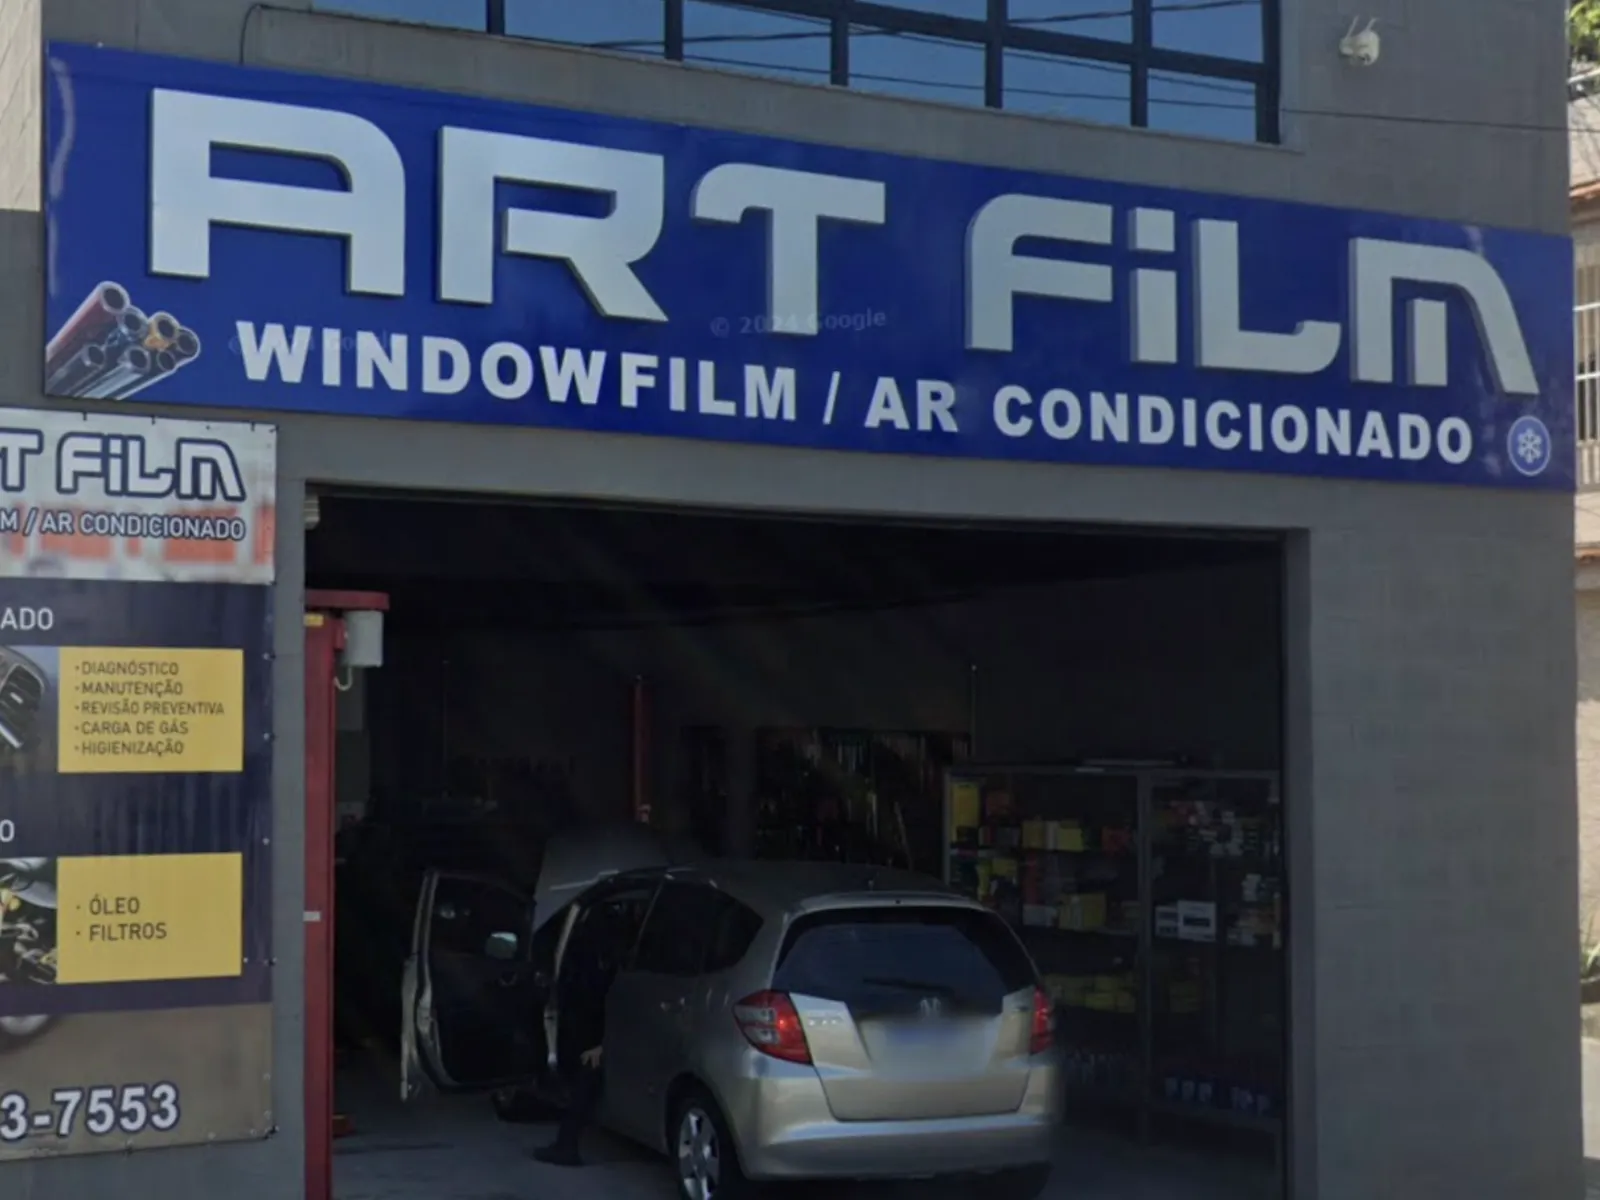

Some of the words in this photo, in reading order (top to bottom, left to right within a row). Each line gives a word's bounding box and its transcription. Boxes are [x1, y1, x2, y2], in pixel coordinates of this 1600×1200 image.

[149, 87, 886, 335] ART
[236, 320, 796, 421] WINDOWFILM
[823, 371, 841, 425] /
[864, 376, 958, 432] AR
[993, 385, 1473, 465] CONDICIONADO
[0, 506, 20, 533] M
[22, 506, 39, 537] /
[40, 509, 74, 536] AR
[78, 511, 246, 541] CONDICIONADO
[0, 606, 53, 630] ADO
[81, 660, 180, 676] DIAGNÓSTICO
[81, 679, 184, 698] MANUTENÇÃO
[81, 698, 139, 715] REVISÃO
[143, 701, 225, 715] PREVENTIVA
[81, 721, 131, 735] CARGA
[136, 721, 154, 734] DE
[159, 718, 189, 735] GÁS
[81, 738, 184, 757] HIGIENIZAÇÃO
[89, 893, 140, 915] ÓLEO
[89, 922, 168, 942] FILTROS
[0, 1080, 180, 1142] 3-7553
